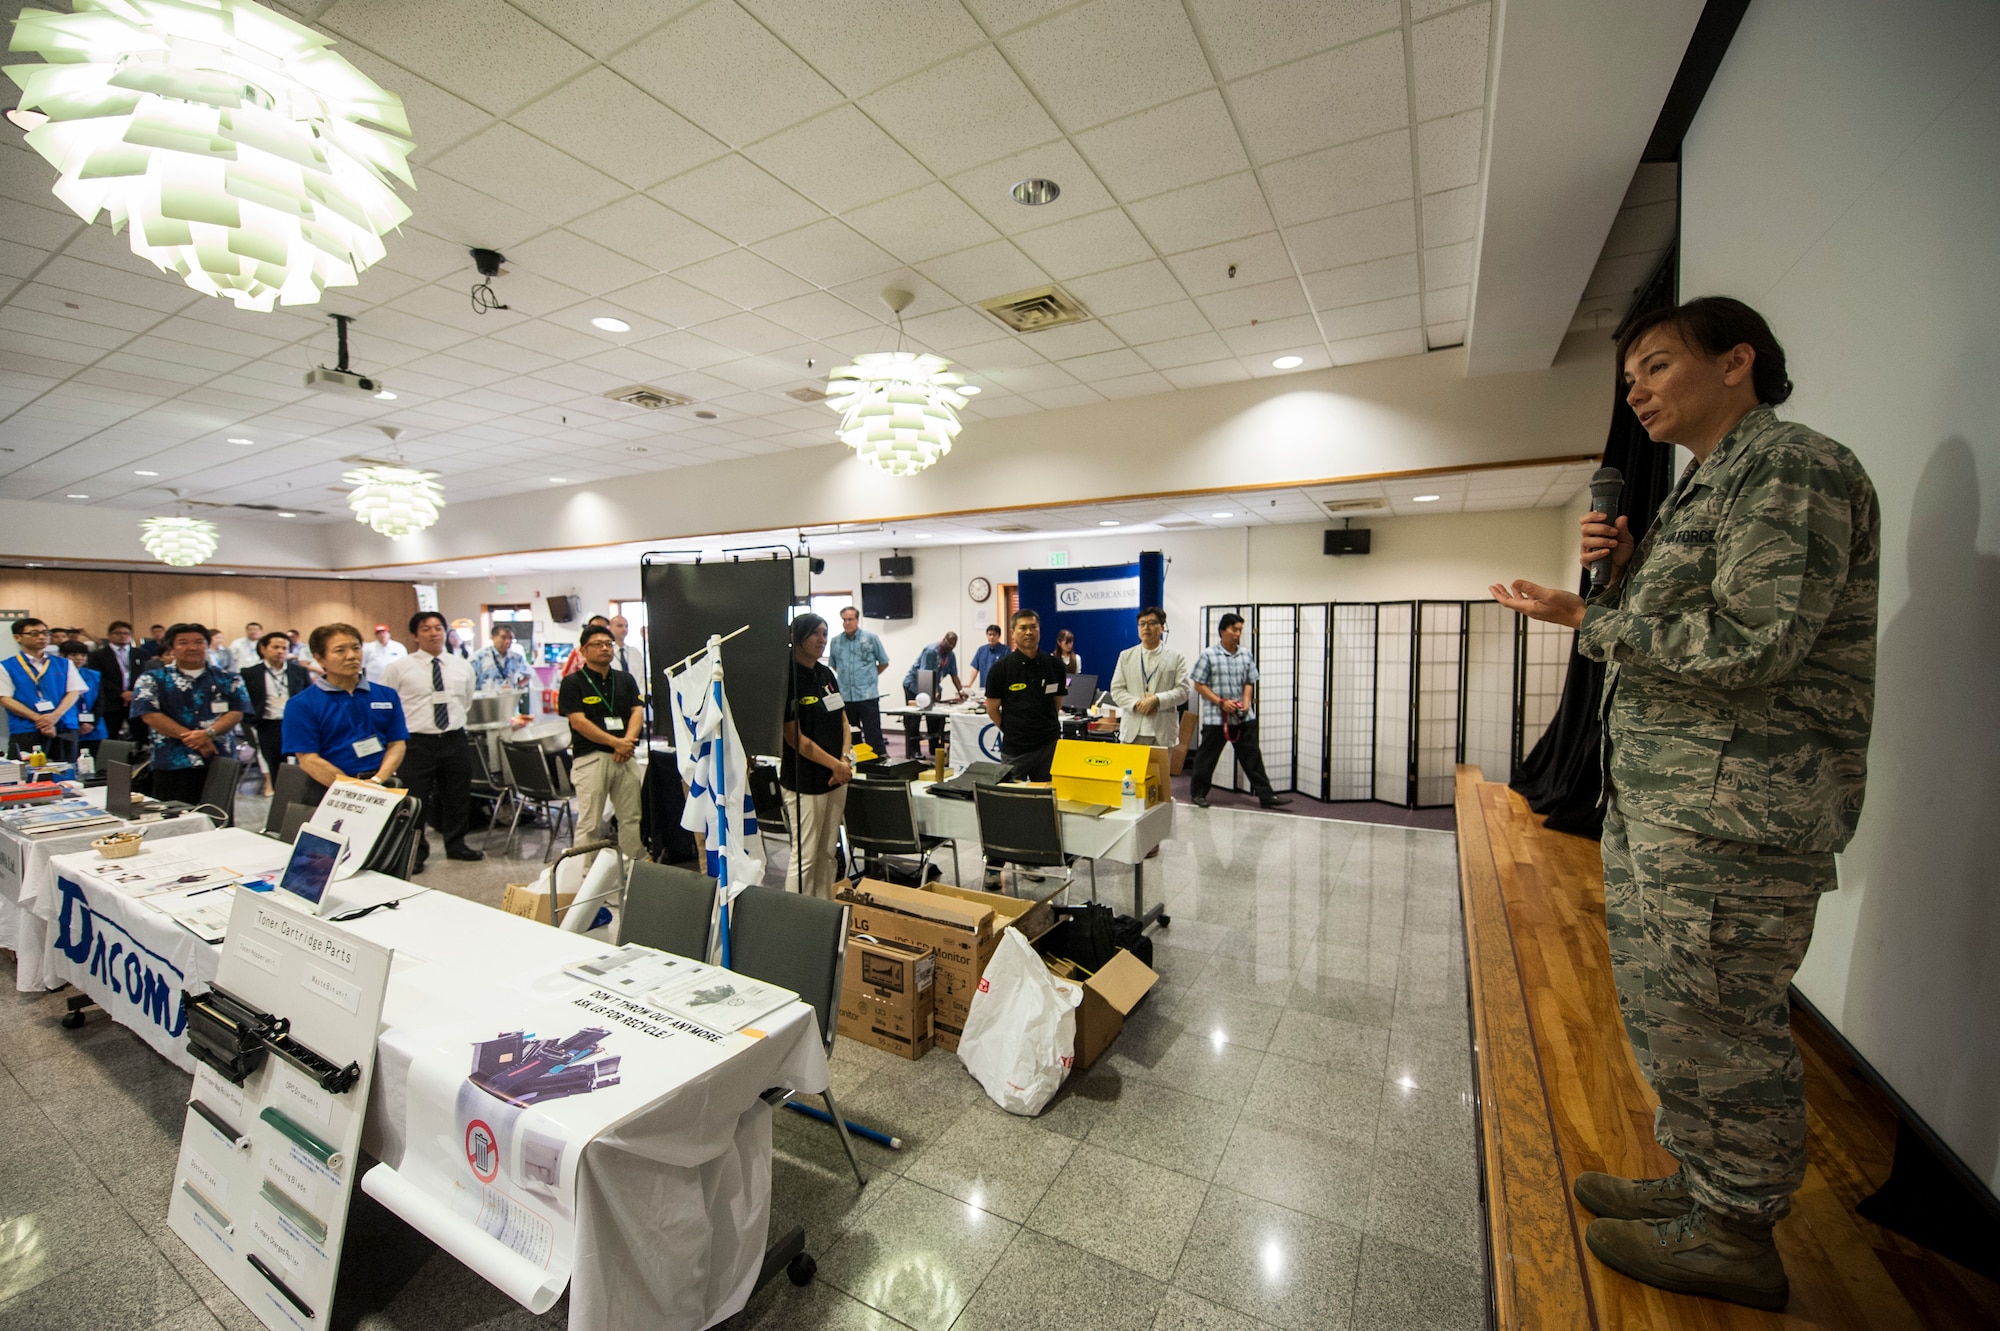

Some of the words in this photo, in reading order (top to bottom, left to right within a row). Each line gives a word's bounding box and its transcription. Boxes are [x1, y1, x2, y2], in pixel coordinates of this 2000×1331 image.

[1051, 552, 1066, 566] EXIT
[1084, 590, 1121, 600] AMERICAN
[855, 918, 869, 931] LG
[258, 910, 278, 930] Toner
[281, 921, 322, 950] Cartridge
[325, 940, 351, 964] Parts
[933, 946, 971, 965] Monitor
[571, 998, 594, 1010] ASK
[590, 1004, 603, 1014] US
[601, 1008, 623, 1021] FOR
[589, 990, 621, 1004] DON'T
[616, 1000, 651, 1016] THROW
[649, 1012, 673, 1024] OUT
